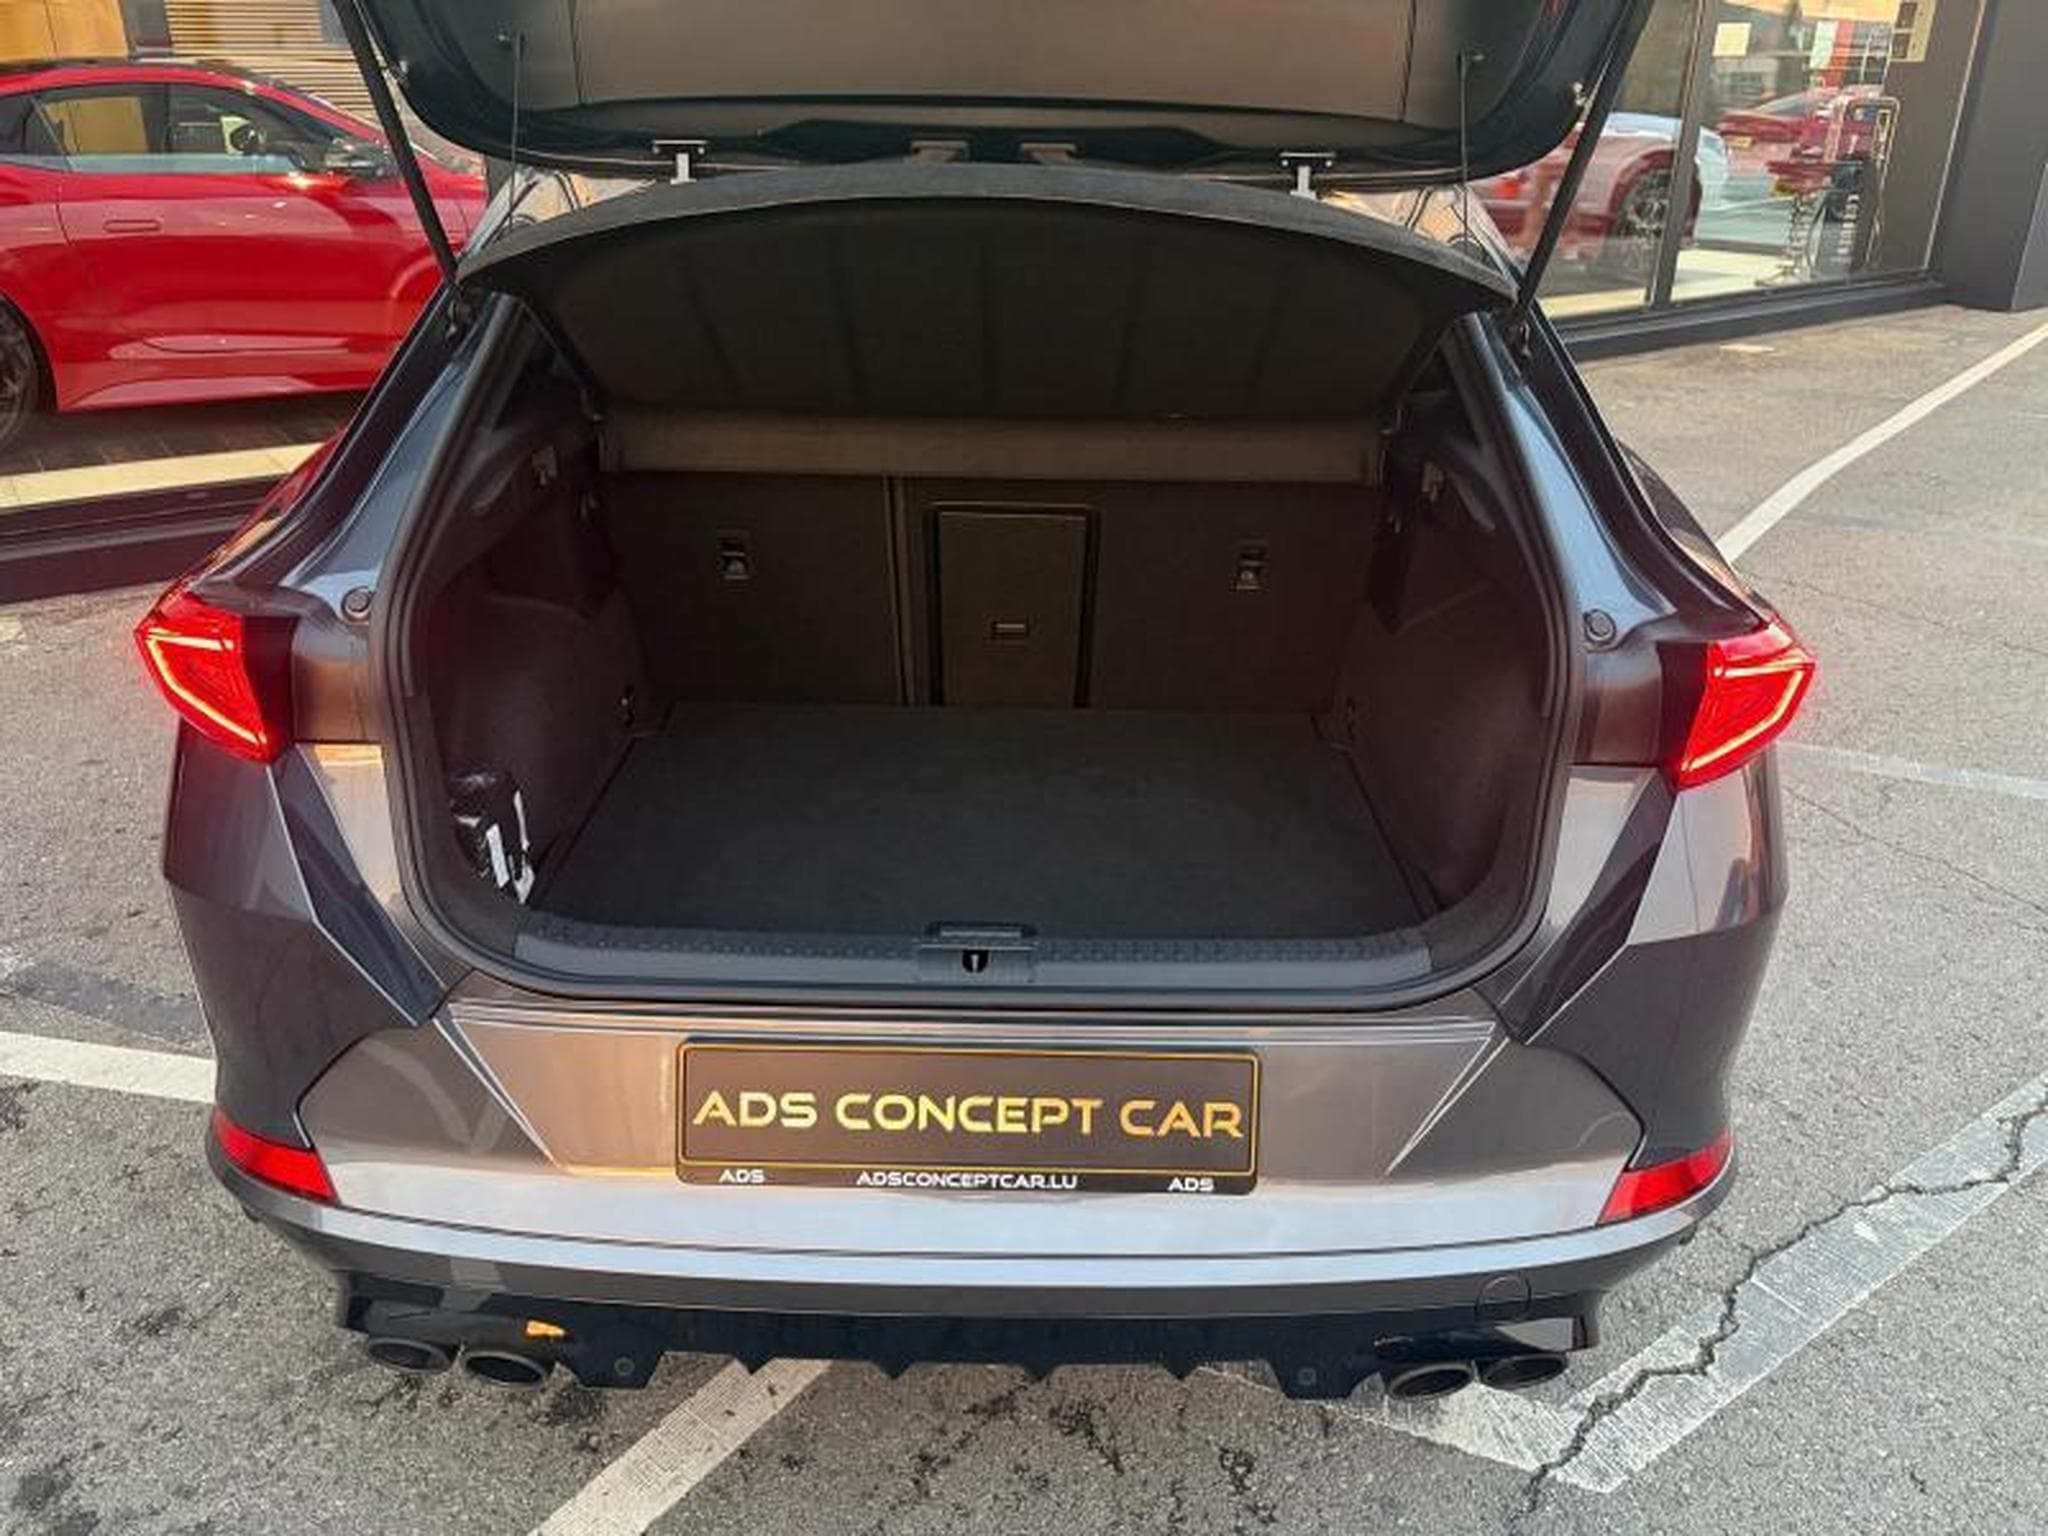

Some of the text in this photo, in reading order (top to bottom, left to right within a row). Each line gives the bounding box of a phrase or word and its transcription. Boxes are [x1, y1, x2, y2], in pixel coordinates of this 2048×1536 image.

[692, 1090, 1243, 1139] ADS CONCEPT CAR
[718, 1168, 765, 1185] ADS
[856, 1171, 1078, 1190] ADSCONCEPTCAR.LU
[1167, 1176, 1214, 1193] ADS
